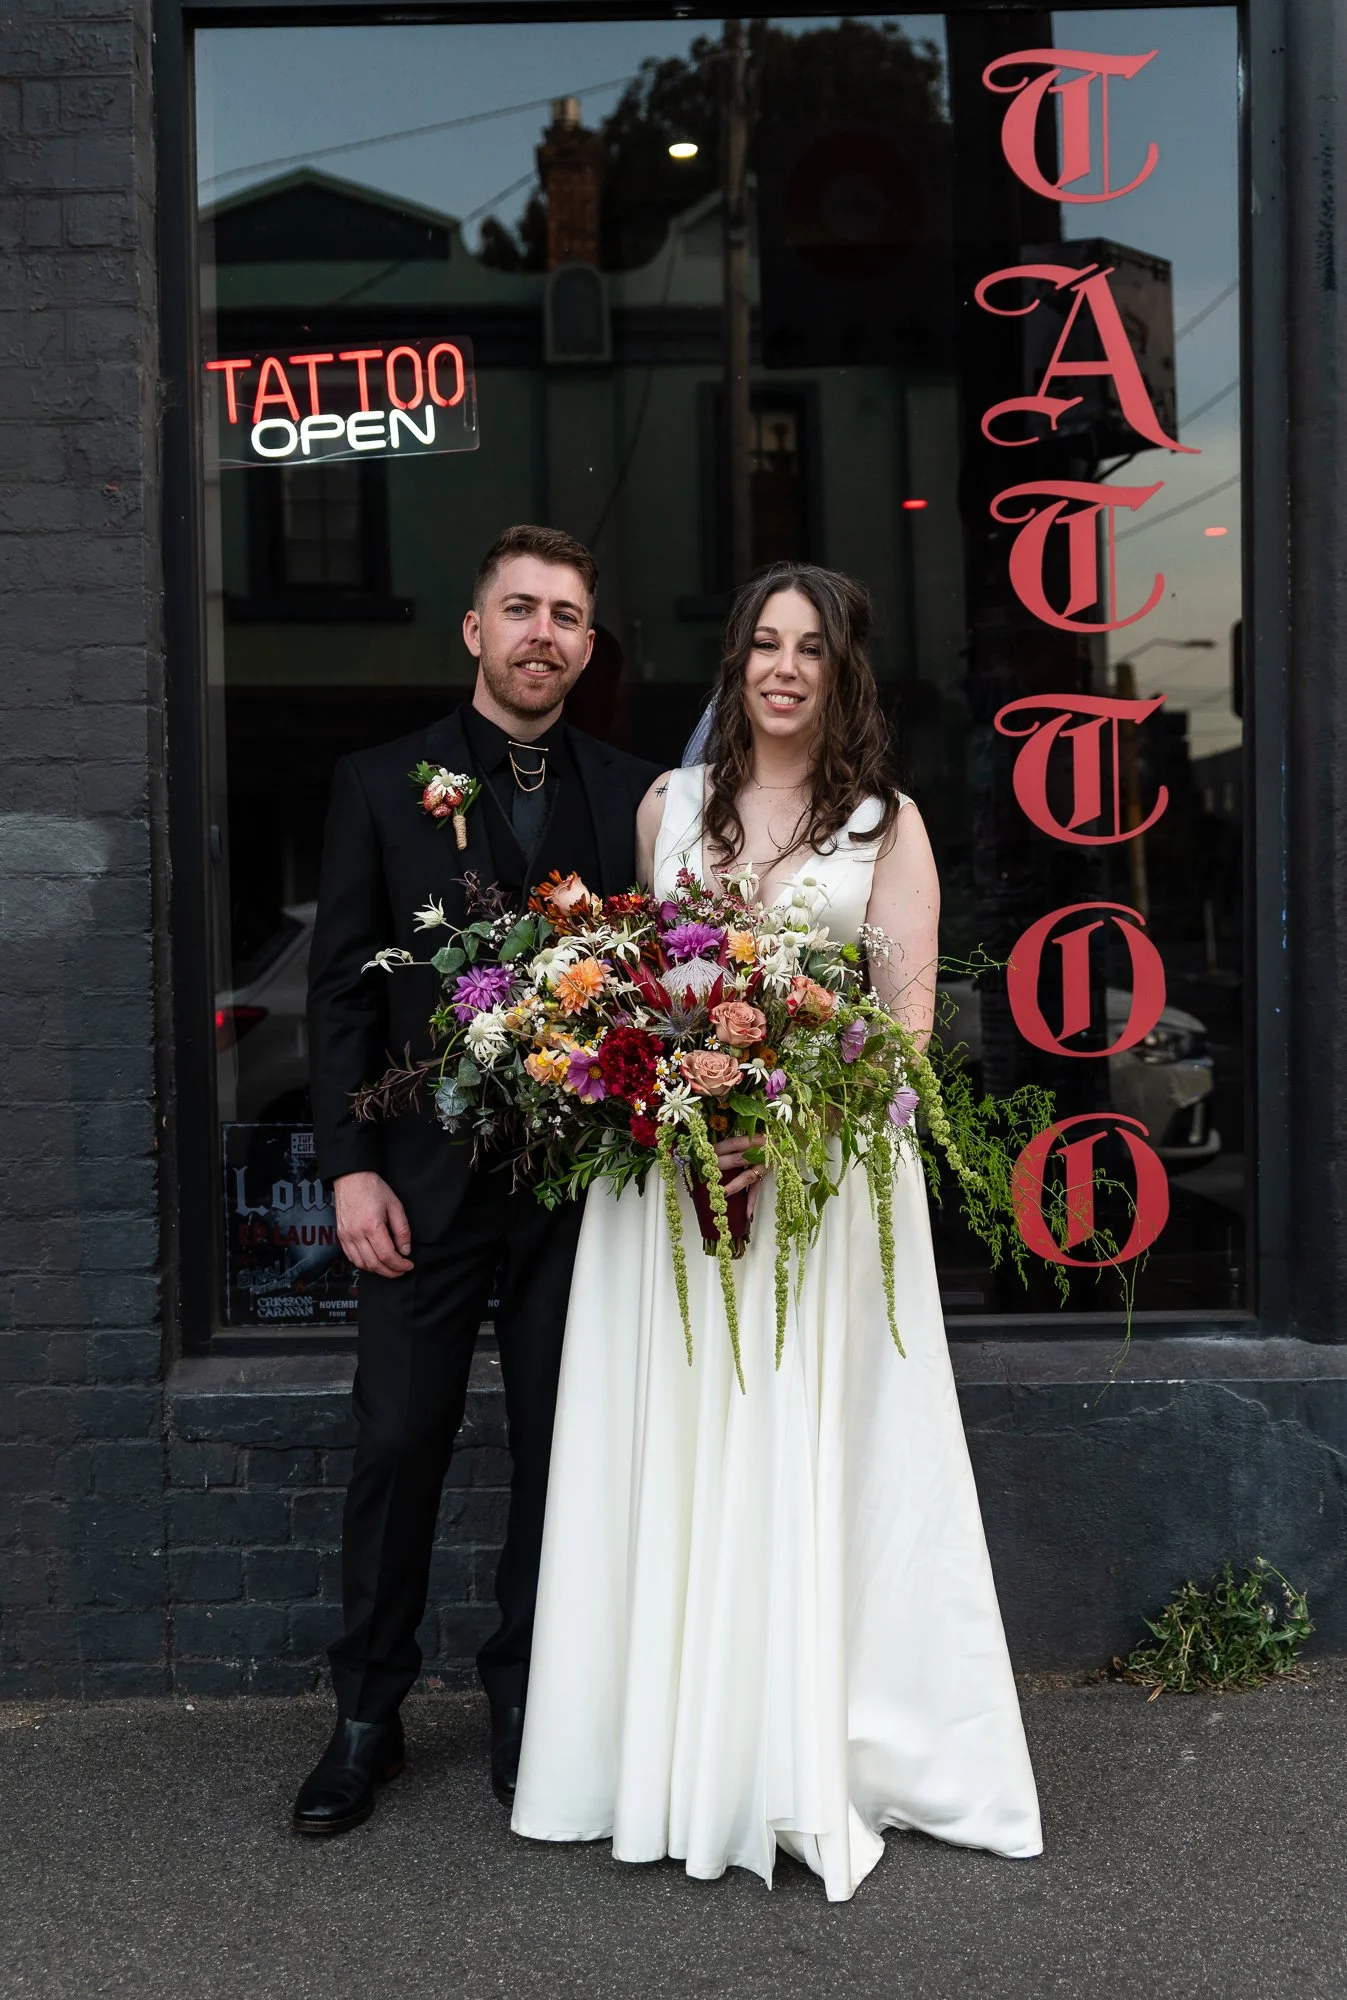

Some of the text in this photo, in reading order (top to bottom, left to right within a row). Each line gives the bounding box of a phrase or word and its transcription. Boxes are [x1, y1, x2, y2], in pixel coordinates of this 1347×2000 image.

[206, 342, 465, 424] TATTOO
[251, 404, 436, 457] OPEN
[974, 48, 1200, 1267] TATTOO
[297, 1135, 316, 1143] TUF
[232, 1166, 336, 1217] Lou
[238, 1224, 338, 1246] EP LAUN
[257, 1296, 313, 1307] CRIMSON
[257, 1307, 313, 1318] CARAVAN
